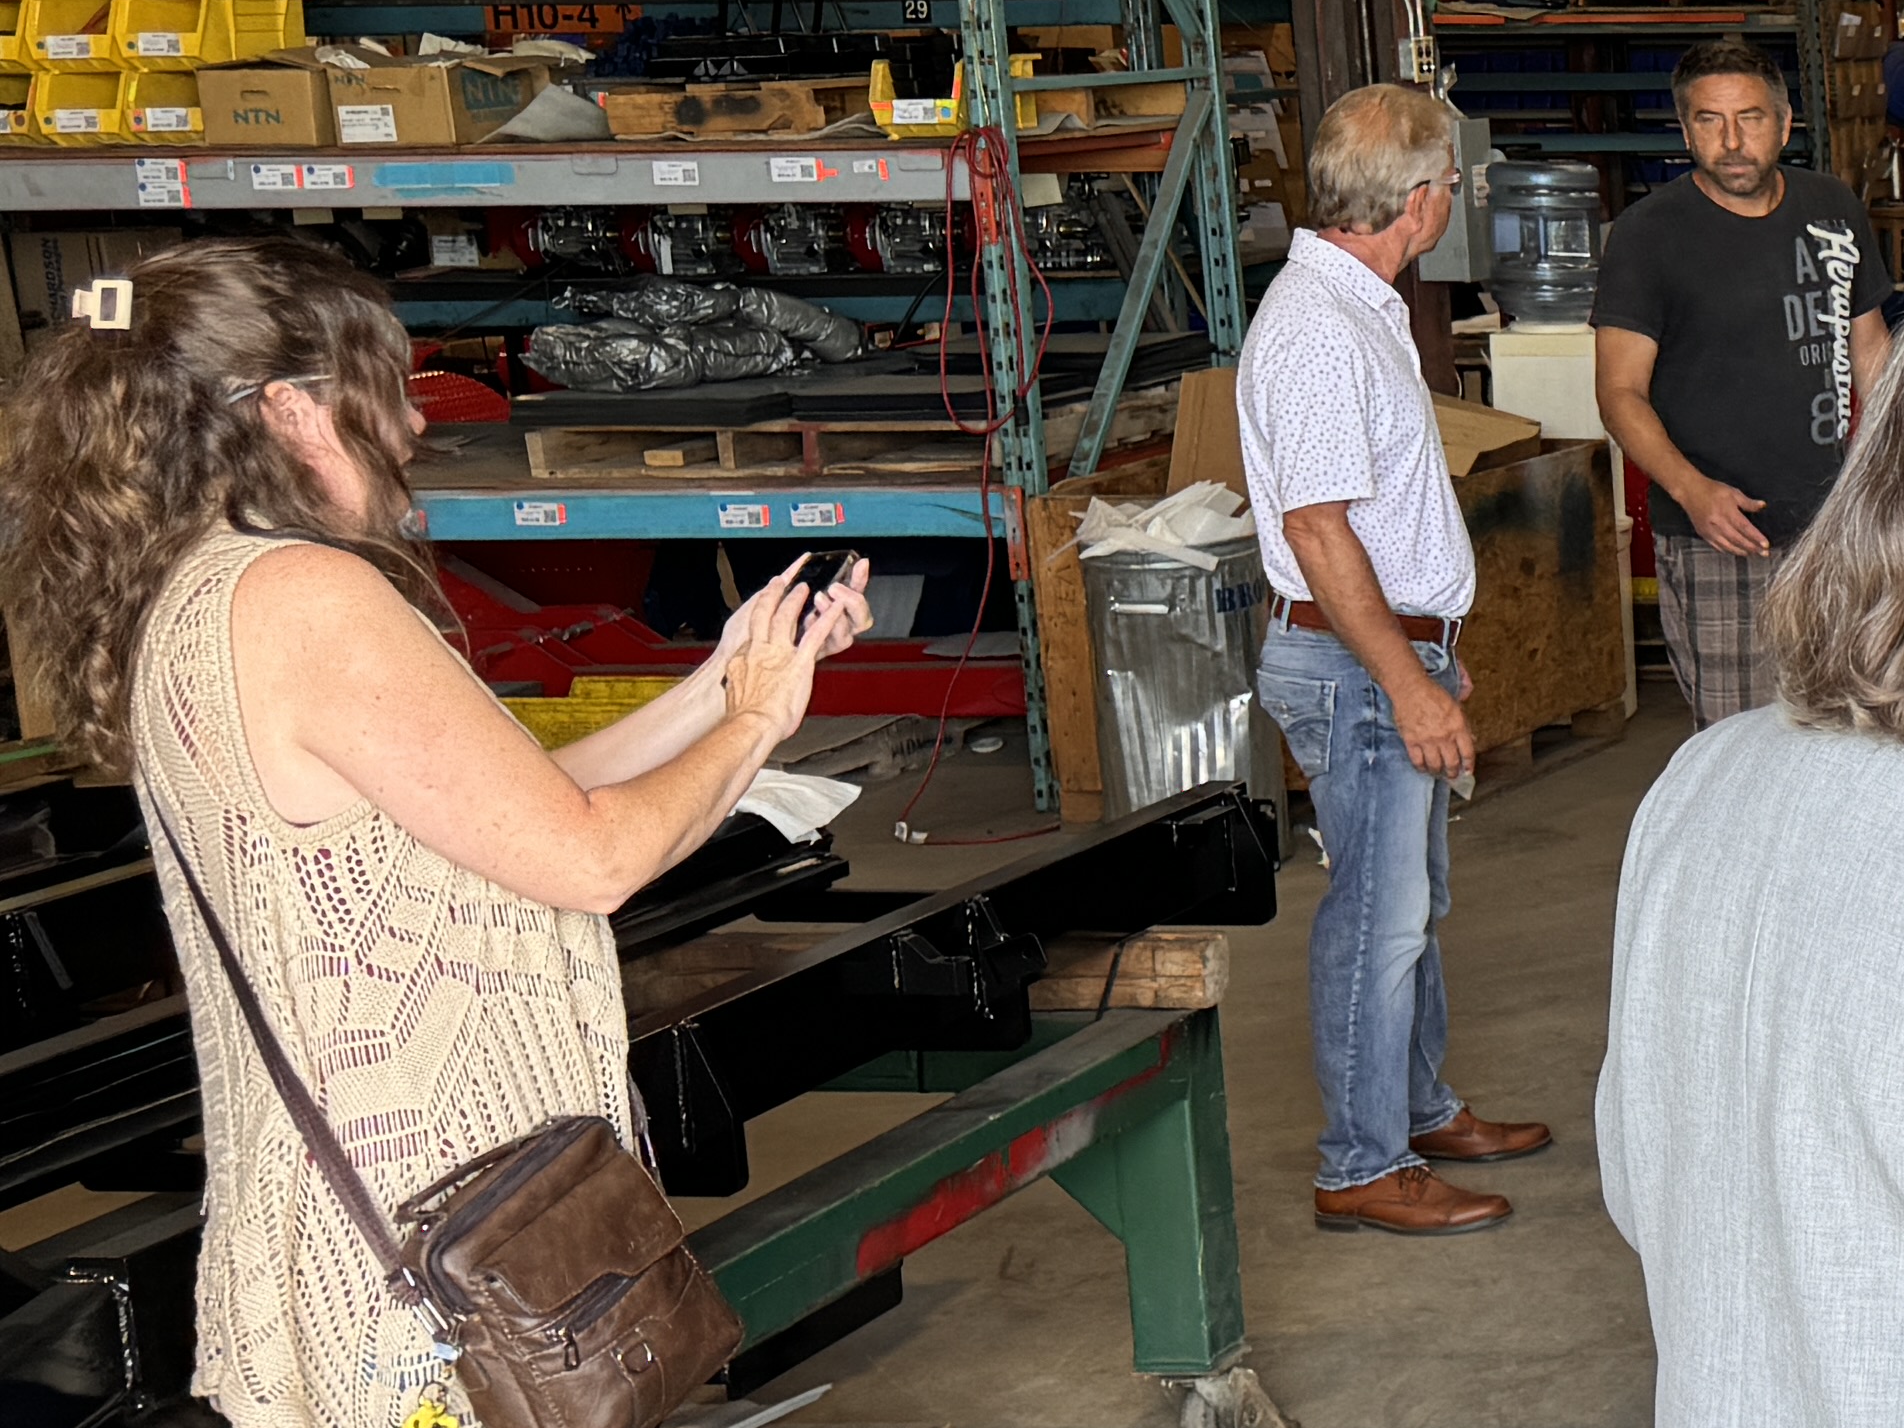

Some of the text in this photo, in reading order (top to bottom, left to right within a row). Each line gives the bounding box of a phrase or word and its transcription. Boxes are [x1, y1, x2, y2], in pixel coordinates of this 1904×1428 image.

[491, 4, 600, 30] H10-4
[905, 0, 929, 19] 29
[232, 108, 282, 126] NTN
